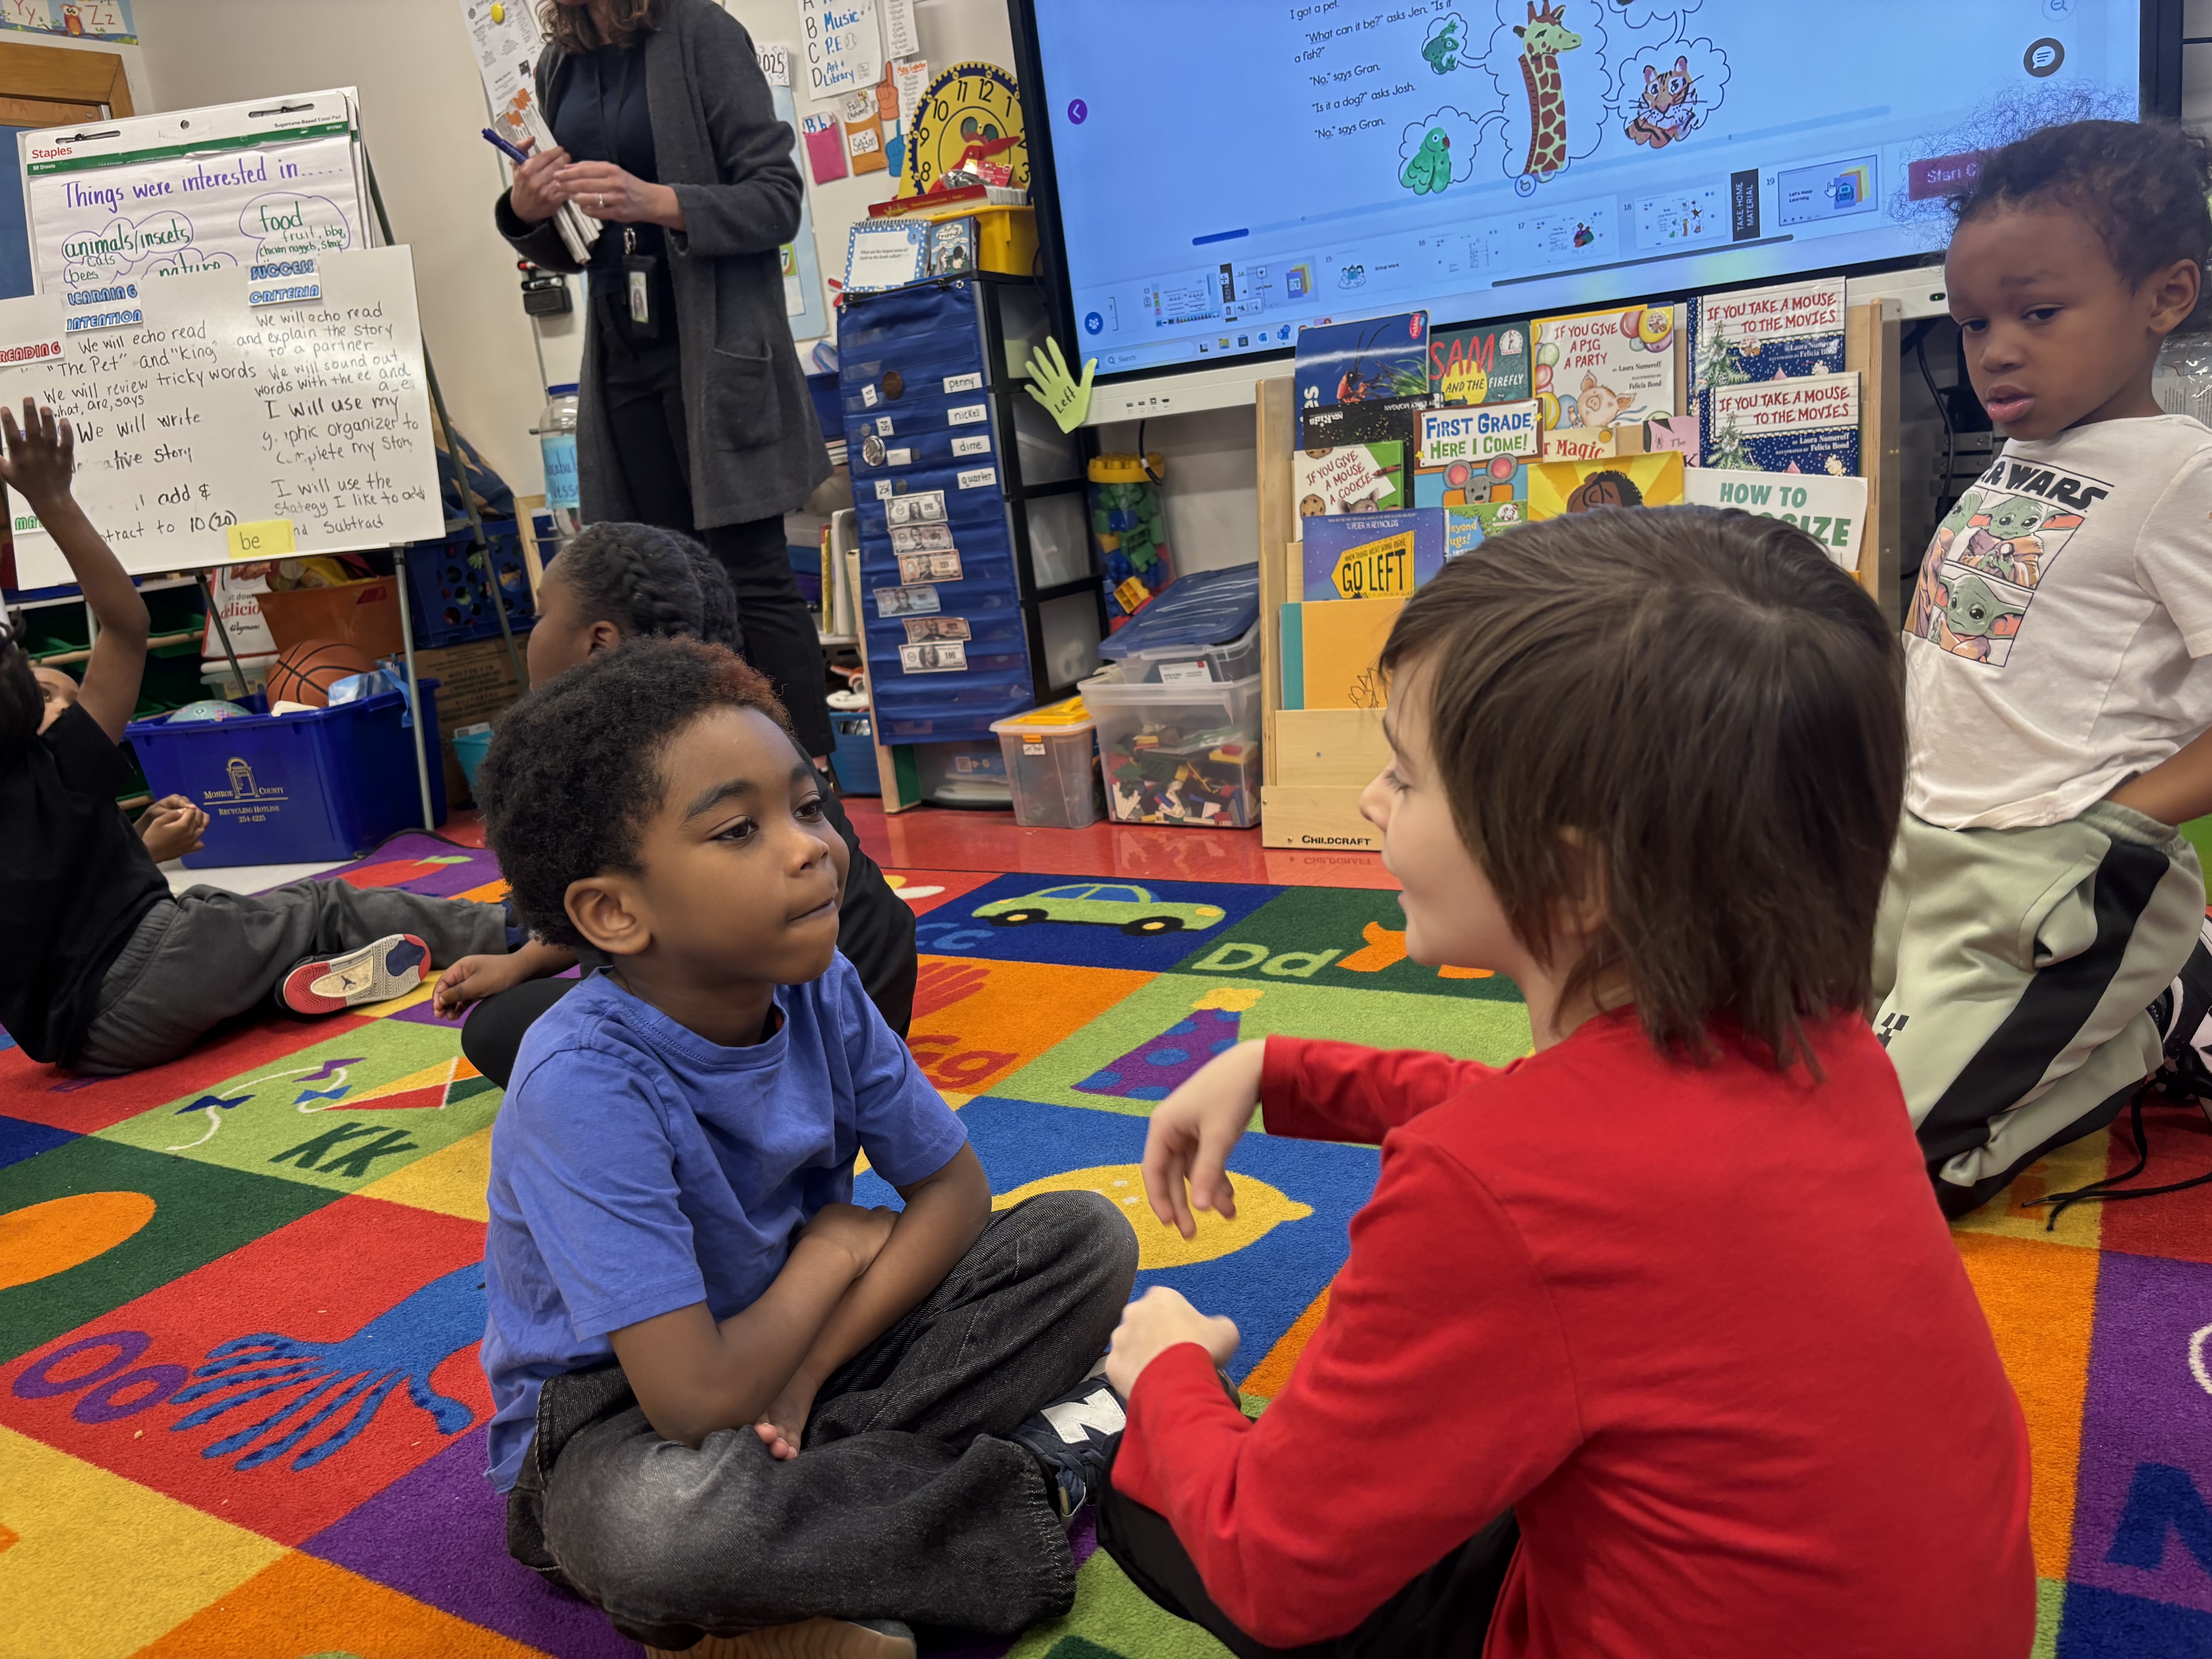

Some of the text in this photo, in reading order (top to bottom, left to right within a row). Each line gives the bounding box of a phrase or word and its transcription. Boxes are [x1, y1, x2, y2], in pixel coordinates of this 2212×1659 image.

[806, 9, 859, 39] B Music
[1298, 7, 1312, 20] got
[1305, 7, 1428, 42] "What can it asks Jen.
[809, 42, 819, 64] C
[812, 67, 822, 88] D
[824, 70, 854, 86] Library
[1334, 63, 1381, 82] says Gran.
[957, 79, 994, 102] 11 12
[1326, 82, 1415, 110] it dog?" asks Josh.
[933, 98, 949, 122] 10
[1338, 117, 1385, 135] says Gran.
[920, 128, 929, 147] 9
[32, 147, 73, 160] Staples
[921, 161, 931, 182] 8
[1928, 168, 1960, 184] Start
[61, 156, 266, 213] Things were interested
[259, 201, 302, 232] food
[324, 225, 346, 239] bbq
[88, 254, 115, 267] cats
[251, 259, 314, 280] SUCCESS
[69, 269, 98, 282] bees
[67, 284, 138, 306] LEARNING
[249, 285, 319, 304] CRITERIA
[256, 301, 382, 328] We will echo read
[1708, 293, 1836, 321] IF YOU TAKE MOUSE
[67, 309, 142, 330] INTENTION
[1741, 310, 1836, 333] TO THE MOVIES
[78, 320, 206, 354] We will echo read
[237, 324, 393, 348] and explain the story
[1554, 322, 1618, 340] IF YOU GIVE
[313, 340, 374, 357] partner
[1580, 339, 1601, 352] PIG
[140, 350, 170, 369] and
[268, 350, 398, 381] We will sound out
[1429, 333, 1495, 380] SAM
[1575, 353, 1607, 368] PARTY
[1636, 361, 1661, 369] Numeroff
[44, 360, 256, 404] We will review tricky words
[255, 363, 411, 397] words with the and
[949, 377, 975, 391] penny
[1445, 373, 1524, 393] AND THE FIREFLY
[1629, 381, 1646, 390] Felicia
[115, 394, 144, 408] says
[331, 395, 398, 421] use my
[1720, 386, 1850, 412] IF YOU TAKE MOUSE
[954, 409, 980, 421] nickel
[1754, 403, 1849, 424] TO THE MOVIES
[77, 407, 201, 443] We write
[328, 417, 397, 440] organizer
[403, 413, 418, 429] to
[1426, 412, 1534, 440] FIRST GRADE,
[352, 442, 376, 461] my
[960, 441, 982, 452] dime
[1430, 433, 1527, 459] HERE COME!
[1557, 439, 1604, 460] Magic
[1671, 438, 1686, 447] The
[1832, 441, 1849, 449] Bond
[154, 443, 192, 464] story
[1306, 450, 1358, 486] IF YOU GIVE
[1334, 463, 1365, 483] MOUSE
[299, 472, 392, 496] will use the
[962, 473, 992, 486] quarter
[1338, 474, 1373, 498] COOKIE
[158, 484, 190, 504] add
[353, 494, 374, 507] like
[1719, 483, 1807, 508] HOW TO
[157, 520, 174, 532] to
[191, 517, 205, 532] 10
[240, 532, 261, 550] be
[1343, 560, 1363, 591] GO
[1369, 549, 1406, 591] LEFT
[1302, 835, 1372, 846] CHILDCRAFT
[1192, 943, 1343, 977] Dd
[12, 1330, 190, 1424] Oo
